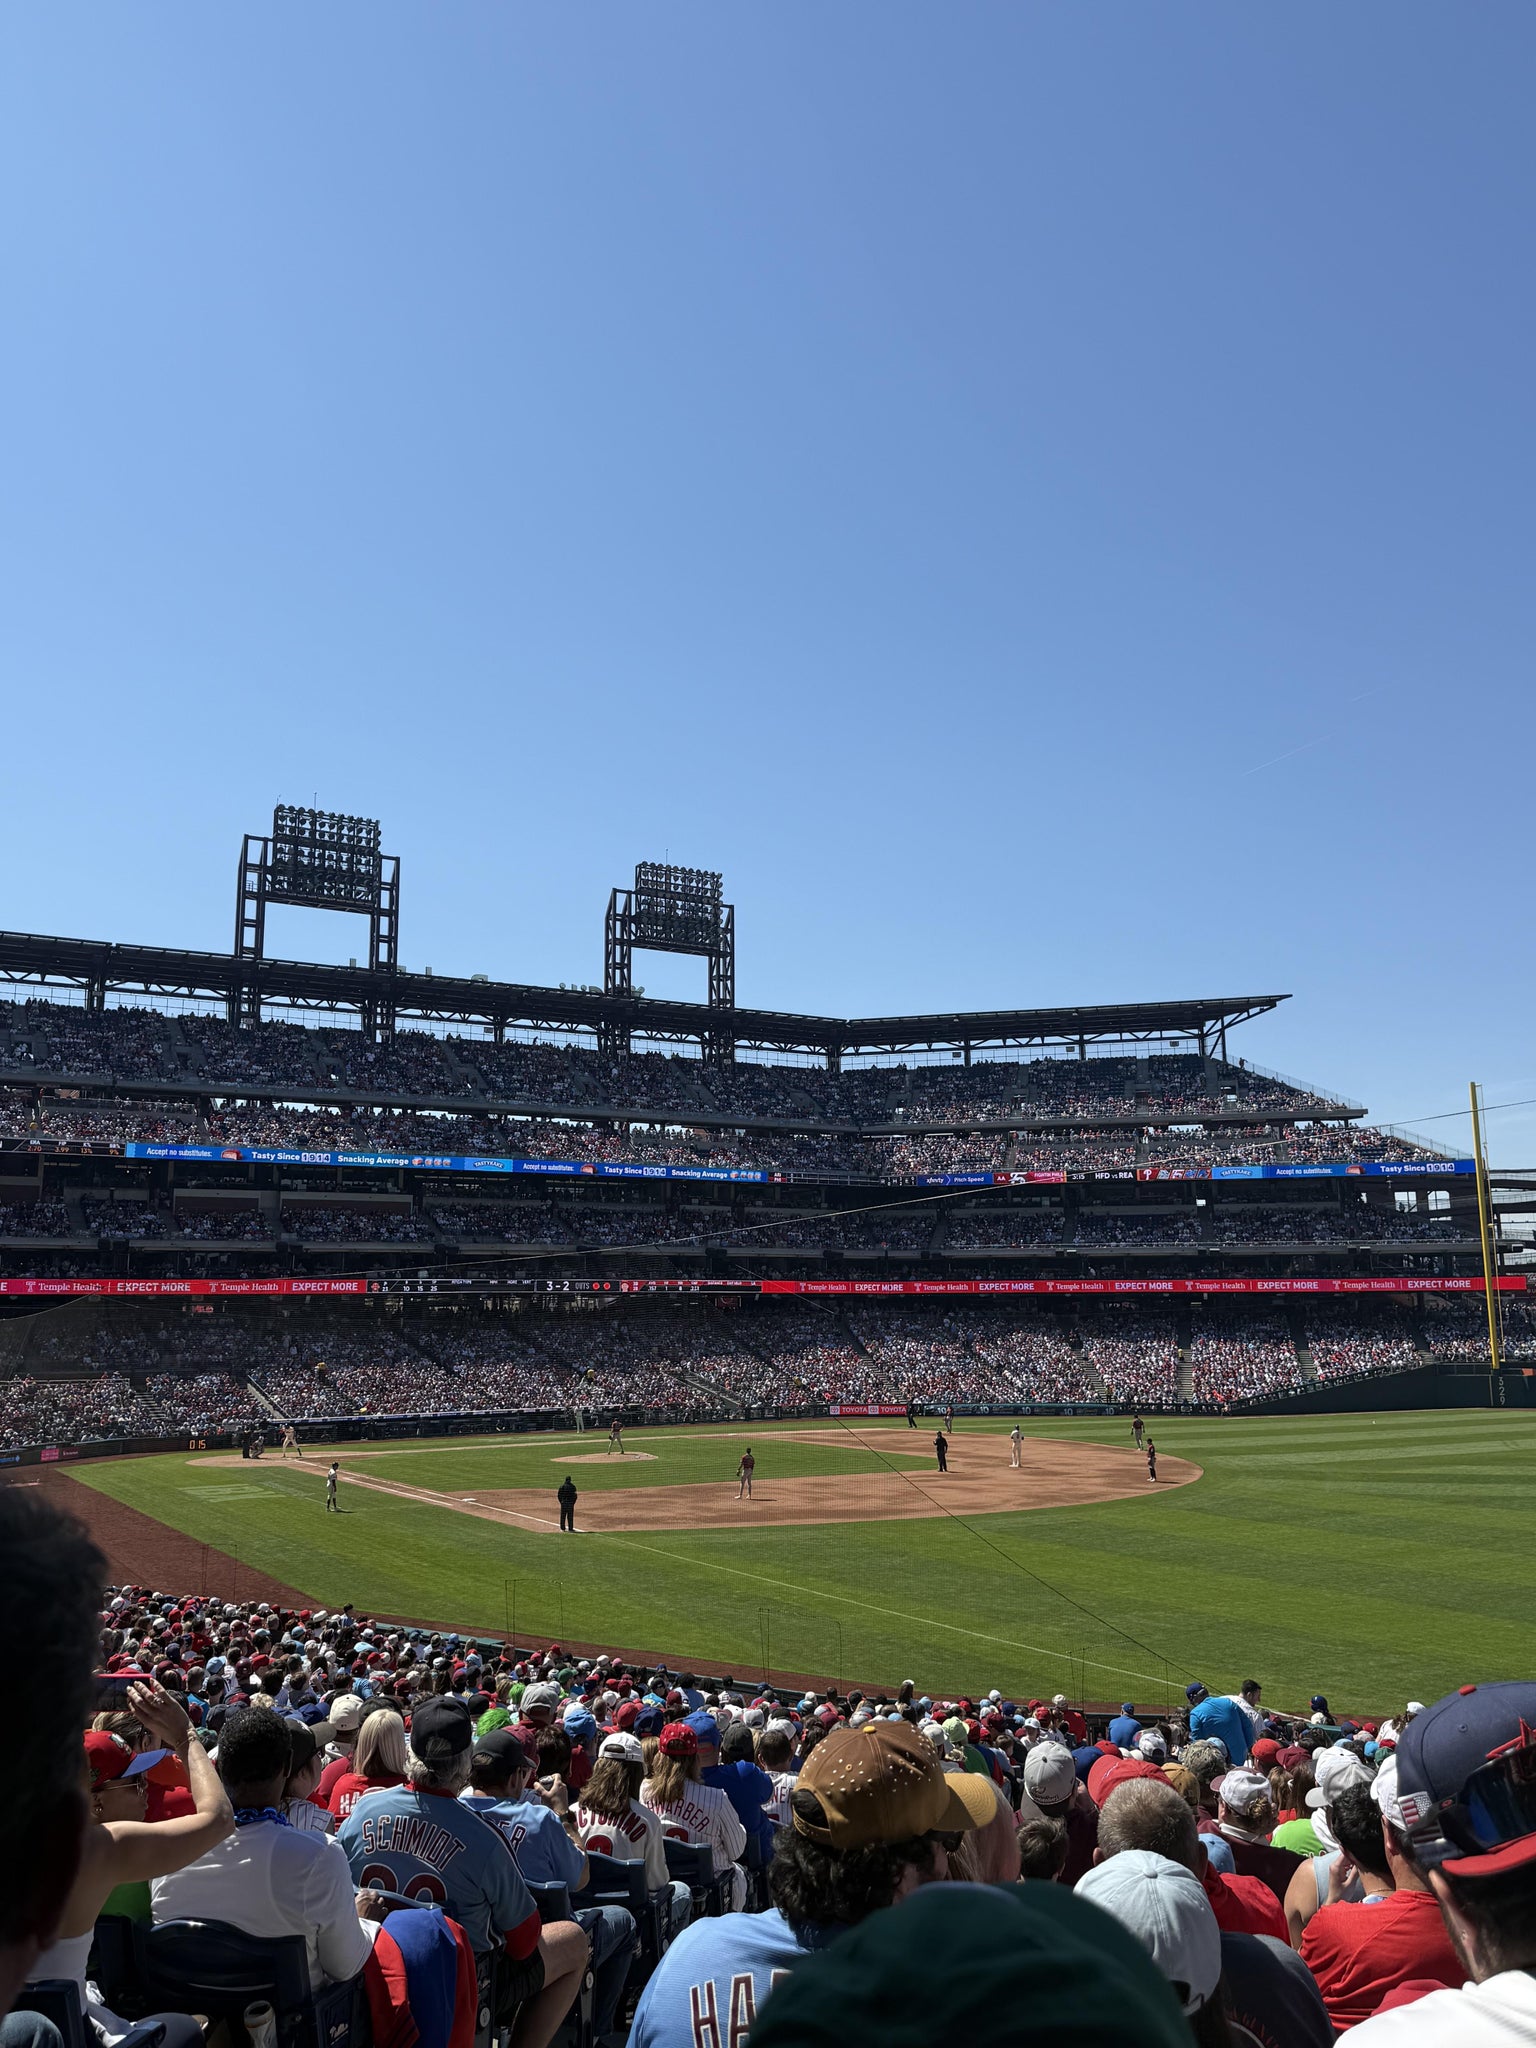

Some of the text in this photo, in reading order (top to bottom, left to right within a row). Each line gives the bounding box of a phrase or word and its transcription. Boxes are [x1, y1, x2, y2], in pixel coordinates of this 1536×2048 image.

[146, 1147, 168, 1156] Accept
[251, 1151, 331, 1163] Tasty Since 1914
[337, 1155, 409, 1166] Snacking Average
[473, 1160, 504, 1170] TASTYKAKE
[523, 1163, 540, 1171] Accept
[1380, 1163, 1455, 1173] Tasty Since 1914
[604, 1166, 666, 1177] Tasty Since 1914
[671, 1169, 728, 1179] Snacking Average
[1095, 1172, 1110, 1180] HFD
[1221, 1168, 1252, 1177] TASTYKAKE
[1276, 1168, 1293, 1177] Accept
[38, 1282, 71, 1292] Temple
[73, 1282, 103, 1291] Health
[116, 1282, 191, 1292] EXPECT MORE
[220, 1283, 250, 1292] Temple
[251, 1282, 279, 1291] Health
[292, 1282, 359, 1291] EXPECT MORE
[575, 1282, 590, 1290] OUTS
[807, 1283, 828, 1292] Temple
[828, 1283, 847, 1291] Health
[855, 1283, 904, 1292] EXPECT MORE
[923, 1283, 946, 1292] Temple
[947, 1283, 968, 1291] Health
[979, 1282, 1035, 1291] EXPECT MORE
[1055, 1283, 1080, 1291] Temple
[1081, 1282, 1104, 1290] Health
[1115, 1282, 1173, 1290] EXPECT MORE
[1195, 1282, 1221, 1291] Temple
[1257, 1281, 1319, 1290] EXPECT MORE
[1342, 1281, 1369, 1289] Temple
[1371, 1280, 1396, 1288] Health
[1407, 1280, 1471, 1288] EXPECT MORE
[979, 1406, 989, 1415] 10
[1022, 1406, 1031, 1415] 10
[1064, 1407, 1073, 1415] 10
[1105, 1407, 1114, 1415] 10
[362, 1813, 466, 1873] SCHMIDT
